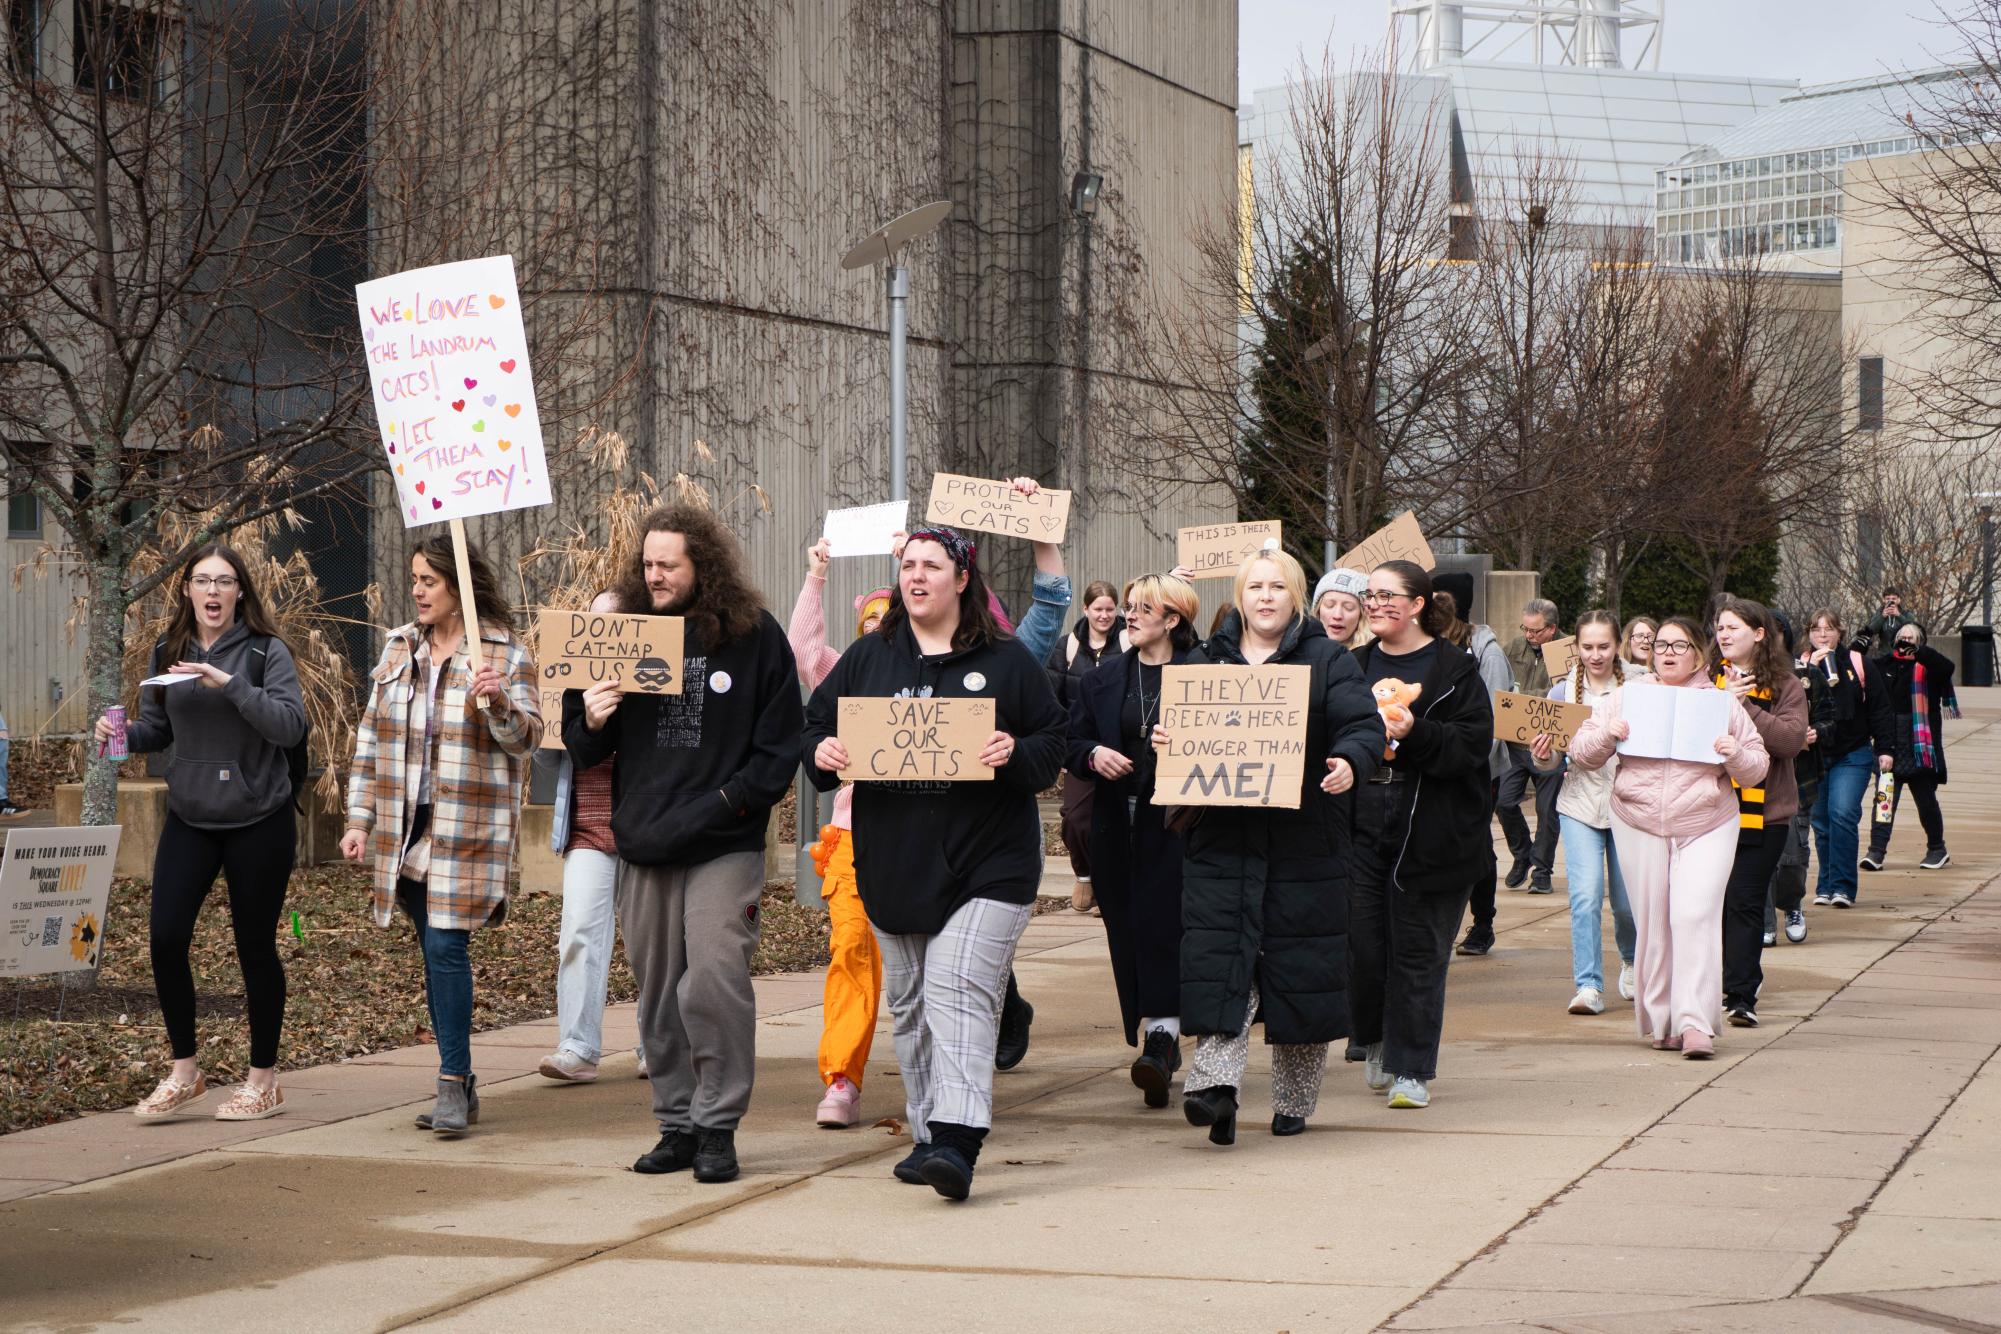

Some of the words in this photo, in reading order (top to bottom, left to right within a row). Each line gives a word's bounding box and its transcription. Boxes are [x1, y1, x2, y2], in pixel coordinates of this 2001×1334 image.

[371, 297, 401, 325] WE
[416, 292, 480, 324] LOVE
[370, 342, 398, 364] THE
[411, 334, 496, 359] LANDRUM
[381, 360, 441, 402] CATS!
[402, 417, 436, 454] LET
[413, 443, 484, 472] THEM
[451, 446, 532, 505] STAY!
[946, 480, 1060, 507] PROTECT
[981, 500, 1012, 511] OUR
[960, 509, 1030, 534] CATS
[1184, 527, 1219, 542] THIS
[1224, 526, 1236, 537] IS
[1241, 524, 1271, 535] THEIR
[1195, 551, 1233, 568] HOME
[571, 614, 648, 638] DON'T
[565, 640, 653, 658] CAT-NAP
[589, 660, 624, 682] US
[1177, 673, 1290, 702] THEY'VE
[886, 700, 951, 727] SAVE
[1164, 708, 1220, 728] BEEN
[1248, 710, 1300, 728] HERE
[1525, 700, 1563, 718] SAVE
[1531, 716, 1562, 731] OUR
[893, 726, 947, 749] OUR
[1168, 738, 1247, 757] LONGER
[1254, 740, 1304, 756] THAN
[1516, 727, 1570, 748] CTS
[871, 749, 963, 776] CATS
[1179, 762, 1275, 805] ME!
[14, 848, 35, 860] MAKE
[38, 847, 57, 859] YOUR
[60, 846, 80, 858] VOICE
[34, 900, 68, 908] WEDNESDAY
